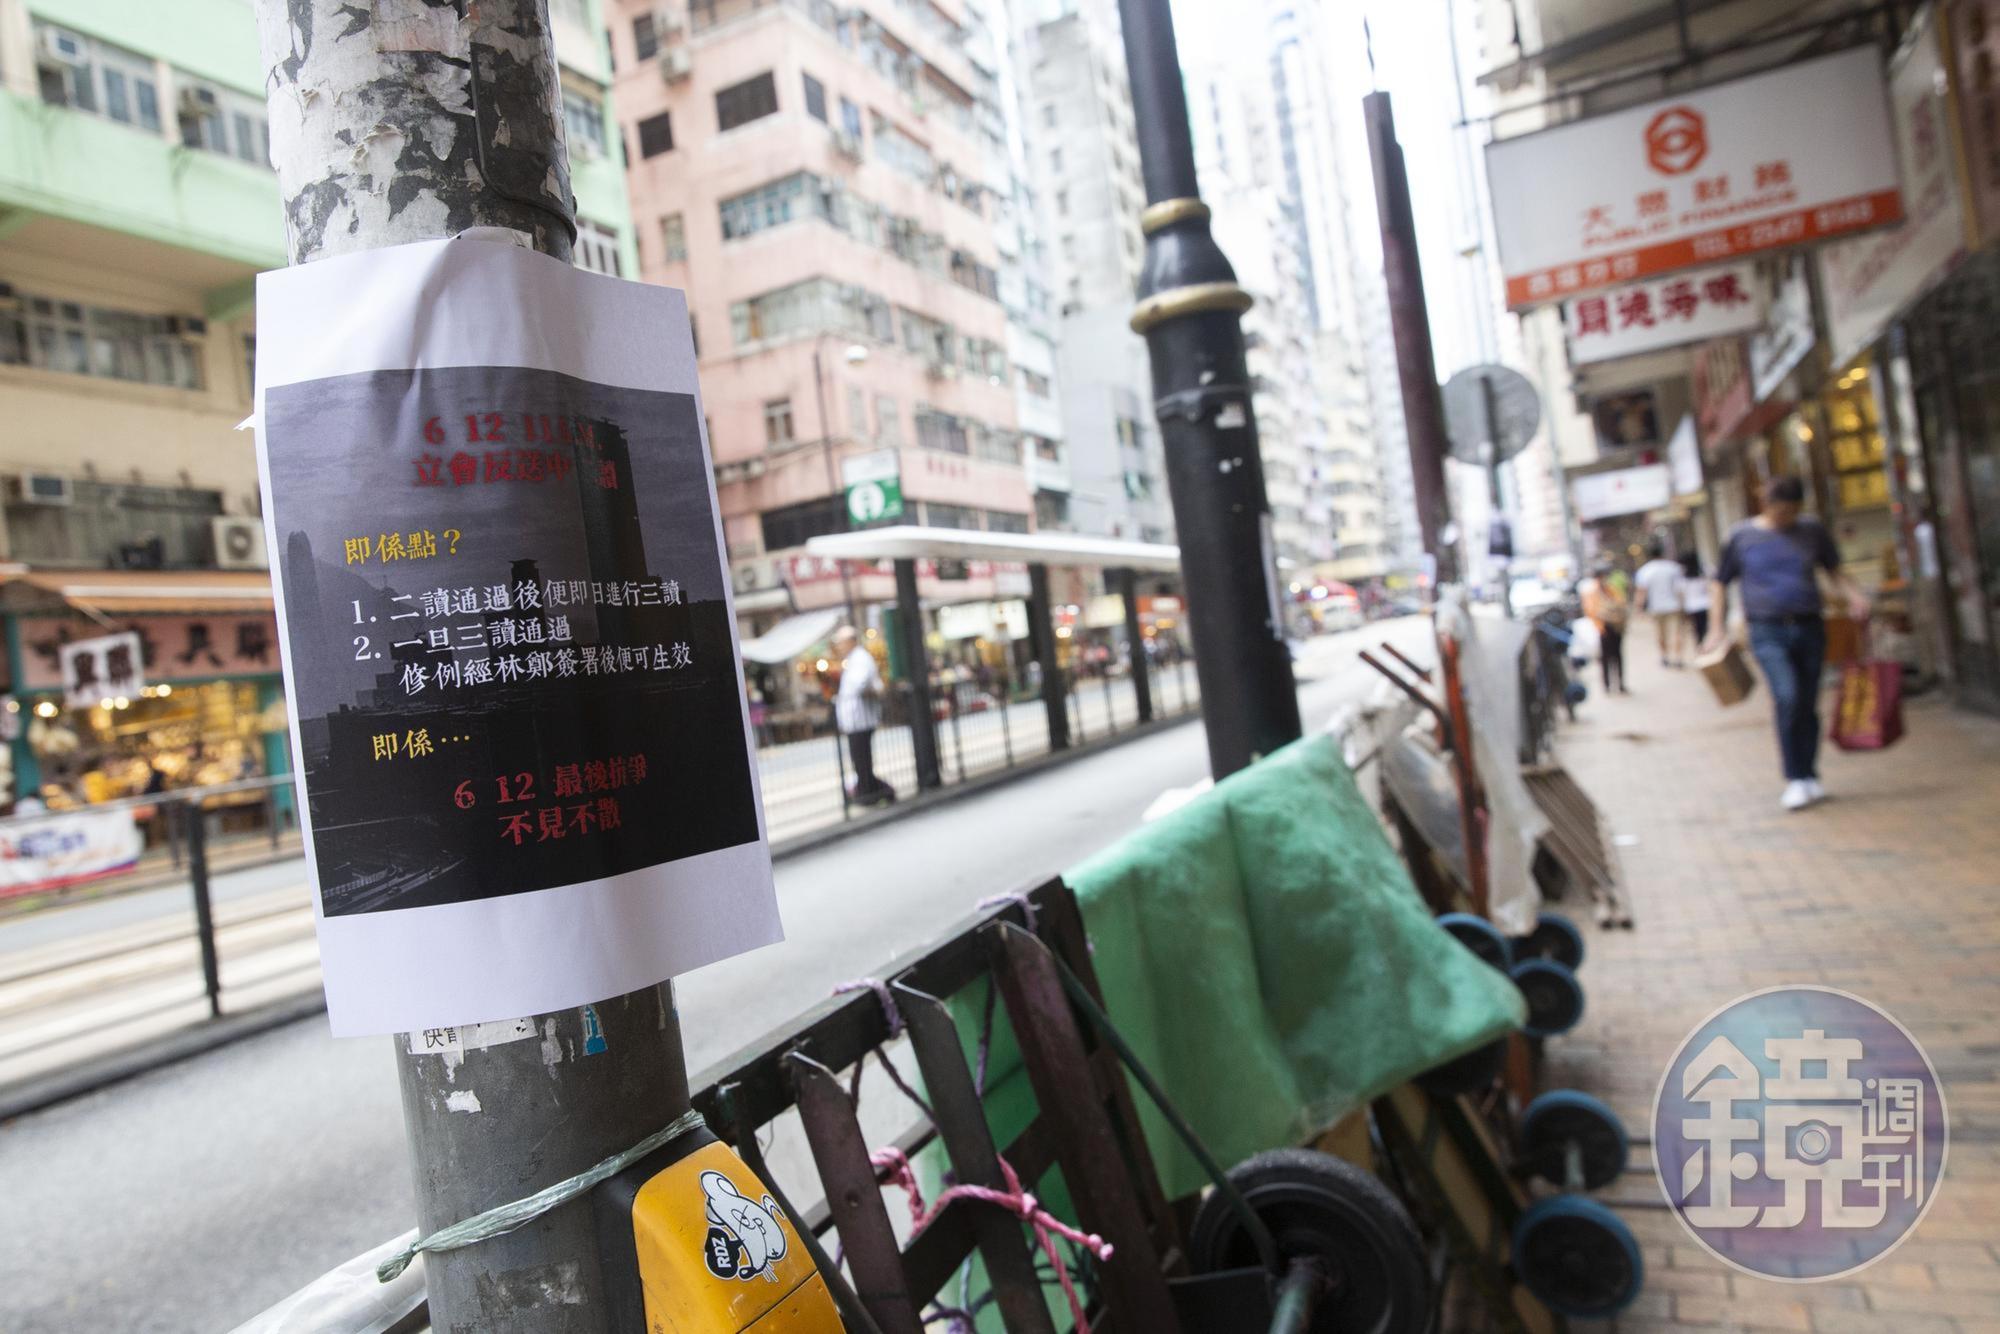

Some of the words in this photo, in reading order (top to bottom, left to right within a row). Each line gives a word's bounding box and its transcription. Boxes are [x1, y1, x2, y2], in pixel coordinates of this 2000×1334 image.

[422, 416, 446, 445] 6
[465, 412, 505, 443] 12
[390, 578, 682, 620] 二讀通過後便即日進行三讀
[393, 615, 573, 653] 一旦三讀通過
[454, 779, 476, 809] 6
[495, 772, 536, 804] 12
[498, 796, 621, 846] 不見不散
[711, 1237, 732, 1268] RDZ
